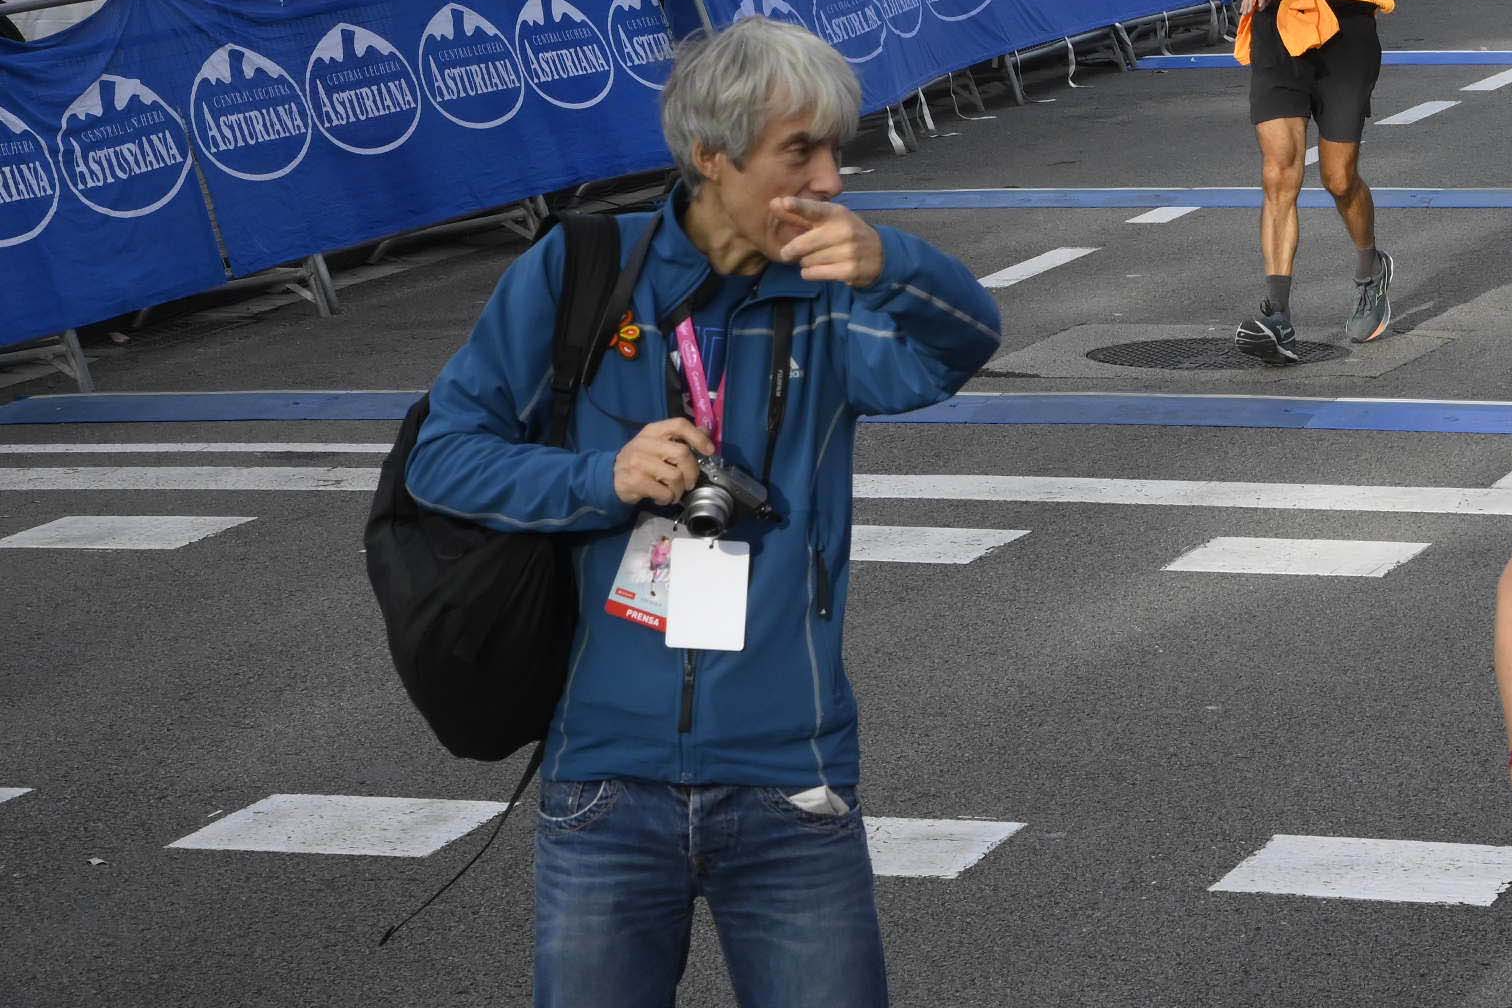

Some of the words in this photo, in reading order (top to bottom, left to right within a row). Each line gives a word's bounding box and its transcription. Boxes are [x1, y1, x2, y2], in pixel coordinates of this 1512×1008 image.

[532, 32, 562, 47] CENTRAL
[562, 27, 593, 42] LECHERA
[437, 47, 473, 63] CENTRAL
[524, 39, 610, 85] ASTURIANA
[327, 69, 364, 87] CENTRAL
[364, 61, 401, 79] LECHERA
[428, 54, 521, 103] ASTURIANA
[213, 92, 252, 108] CENTRAL
[315, 77, 417, 129] ASTURIANA
[81, 126, 124, 143] CENTRAL
[202, 100, 306, 153] ASTURIANA
[625, 608, 660, 627] PRENSA
